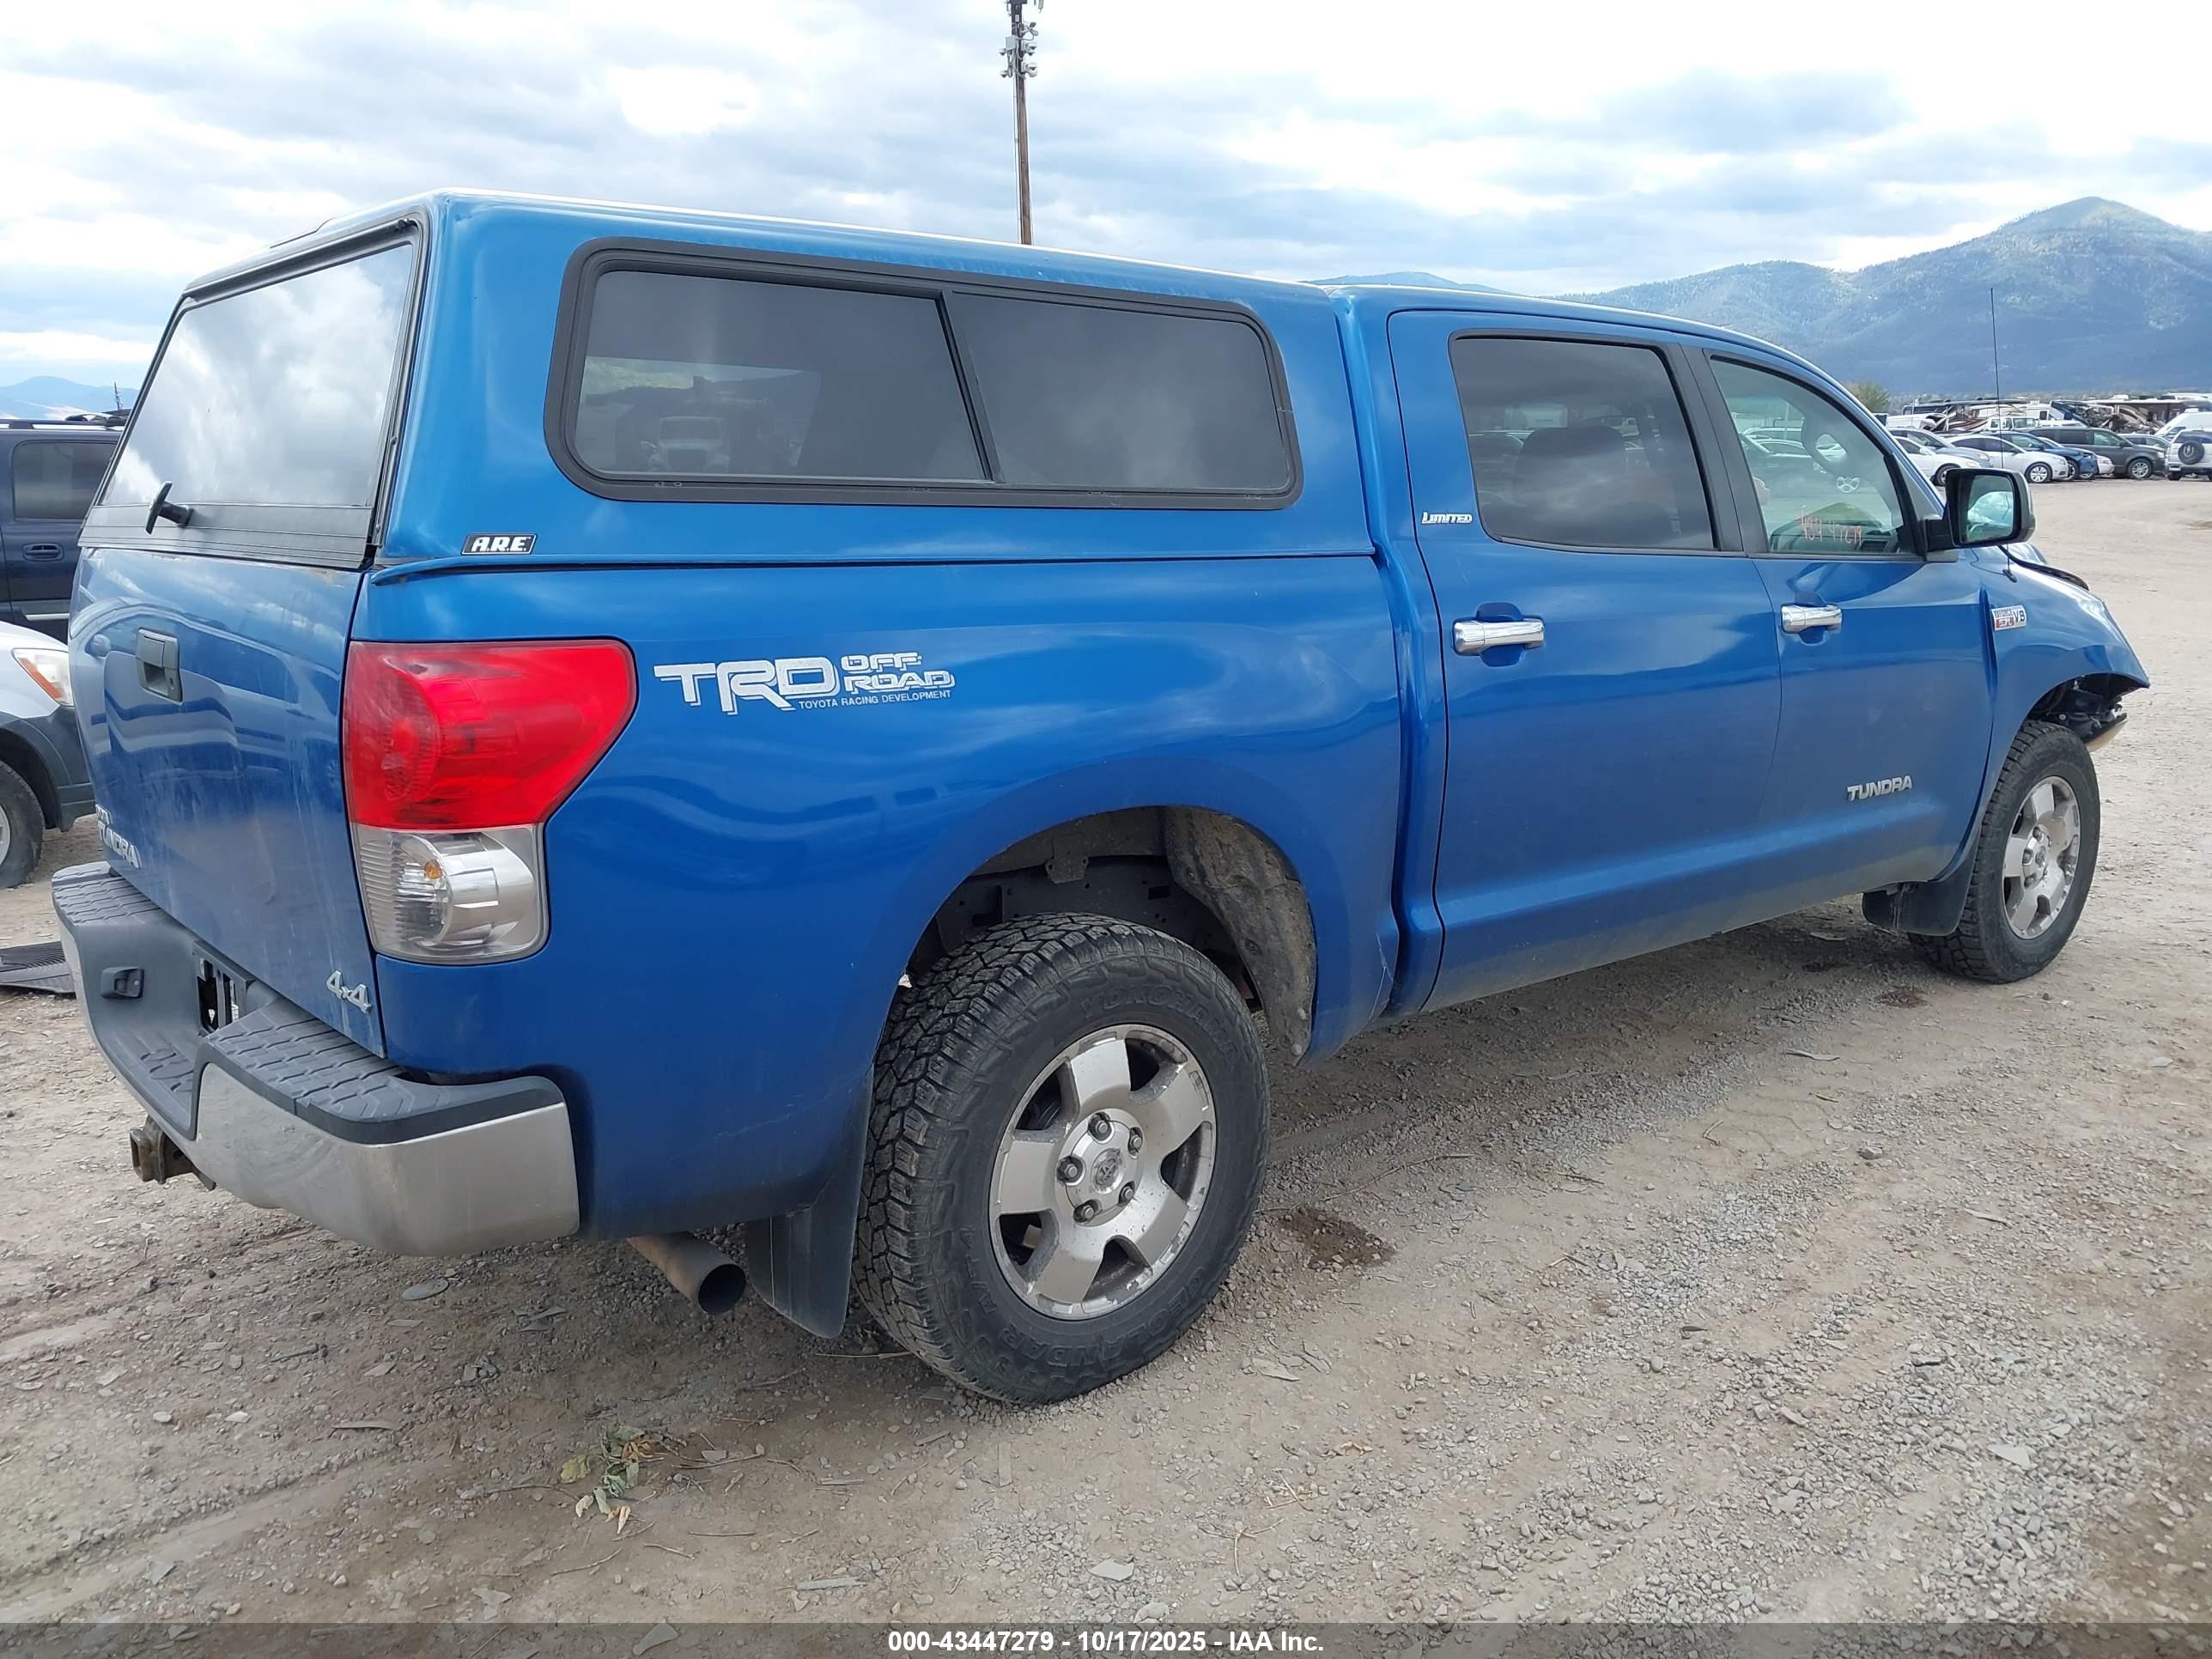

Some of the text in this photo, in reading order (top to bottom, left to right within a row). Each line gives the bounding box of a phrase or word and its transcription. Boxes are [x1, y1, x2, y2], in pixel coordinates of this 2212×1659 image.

[1421, 511, 1473, 524] LIMITED
[471, 536, 528, 552] A.R.E.
[2013, 610, 2026, 623] V8
[841, 652, 922, 674] OFF
[653, 656, 841, 716] TRD
[843, 670, 956, 695] ROAD
[799, 690, 952, 710] TOYOTA RACING DEVELOPMENT
[1847, 775, 1913, 802] TUNDRA
[1079, 986, 1238, 1066] YOKOHAMA
